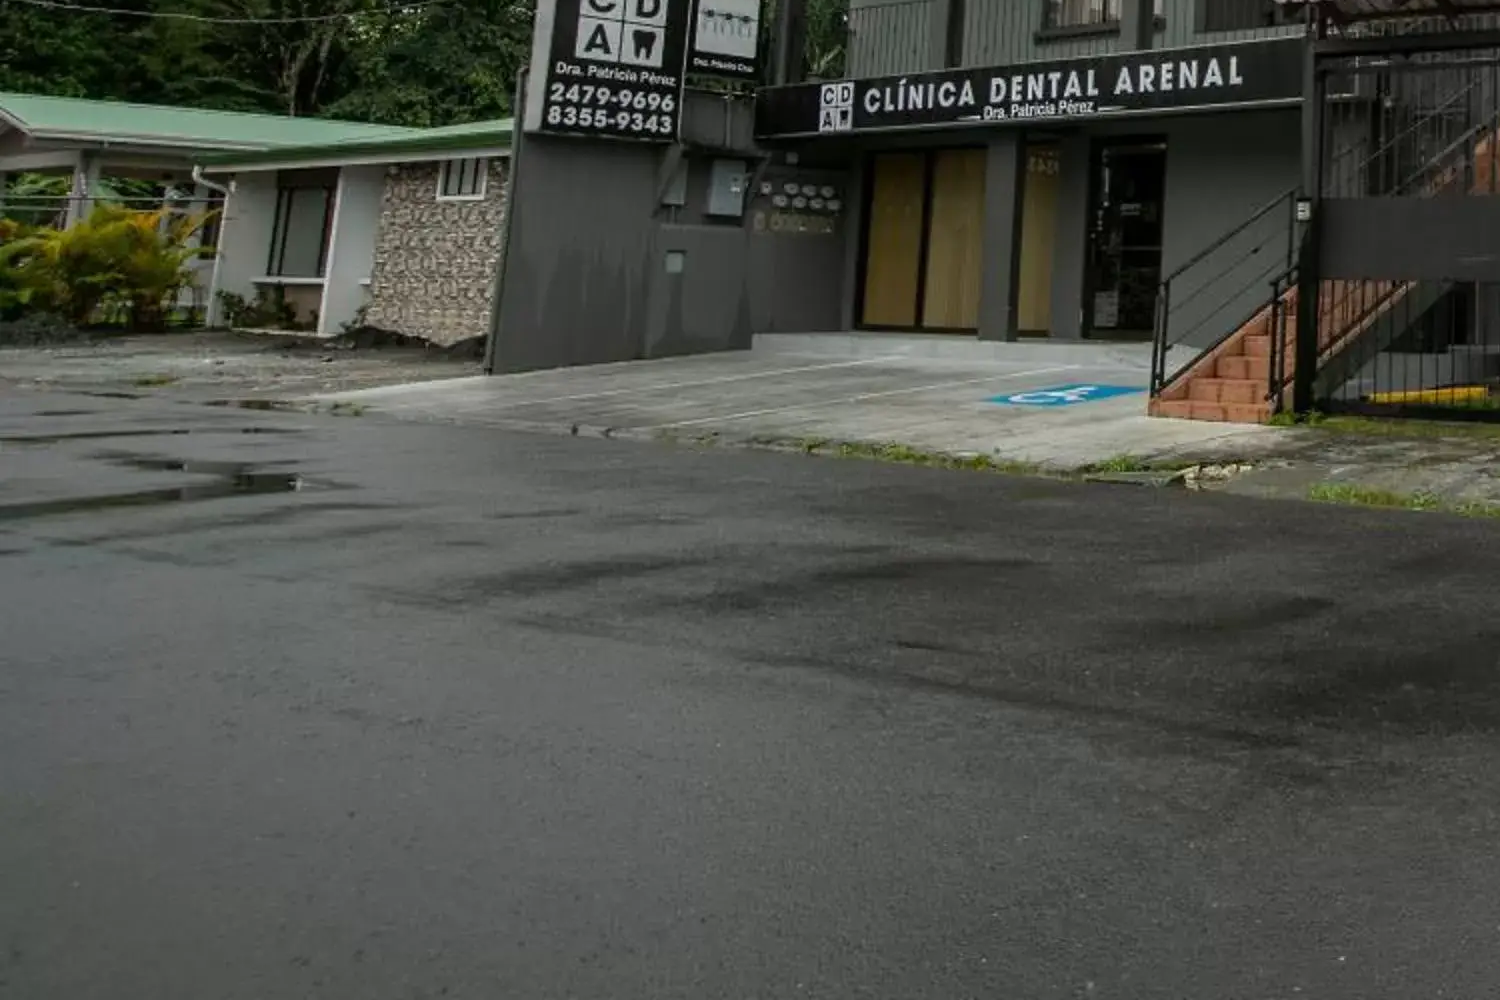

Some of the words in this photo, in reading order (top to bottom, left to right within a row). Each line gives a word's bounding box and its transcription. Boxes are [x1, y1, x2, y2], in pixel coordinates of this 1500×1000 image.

[583, 23, 612, 54] A
[555, 61, 584, 76] Dra.
[587, 65, 637, 81] Patricia
[864, 78, 975, 113] CLÍNICA
[989, 69, 1099, 103] DENTAL
[1113, 55, 1243, 95] ARENAL
[550, 82, 675, 112] 2479-9696
[983, 105, 1006, 119] Dra.
[1011, 101, 1056, 117] Patricia
[547, 105, 672, 134] 8355-9343
